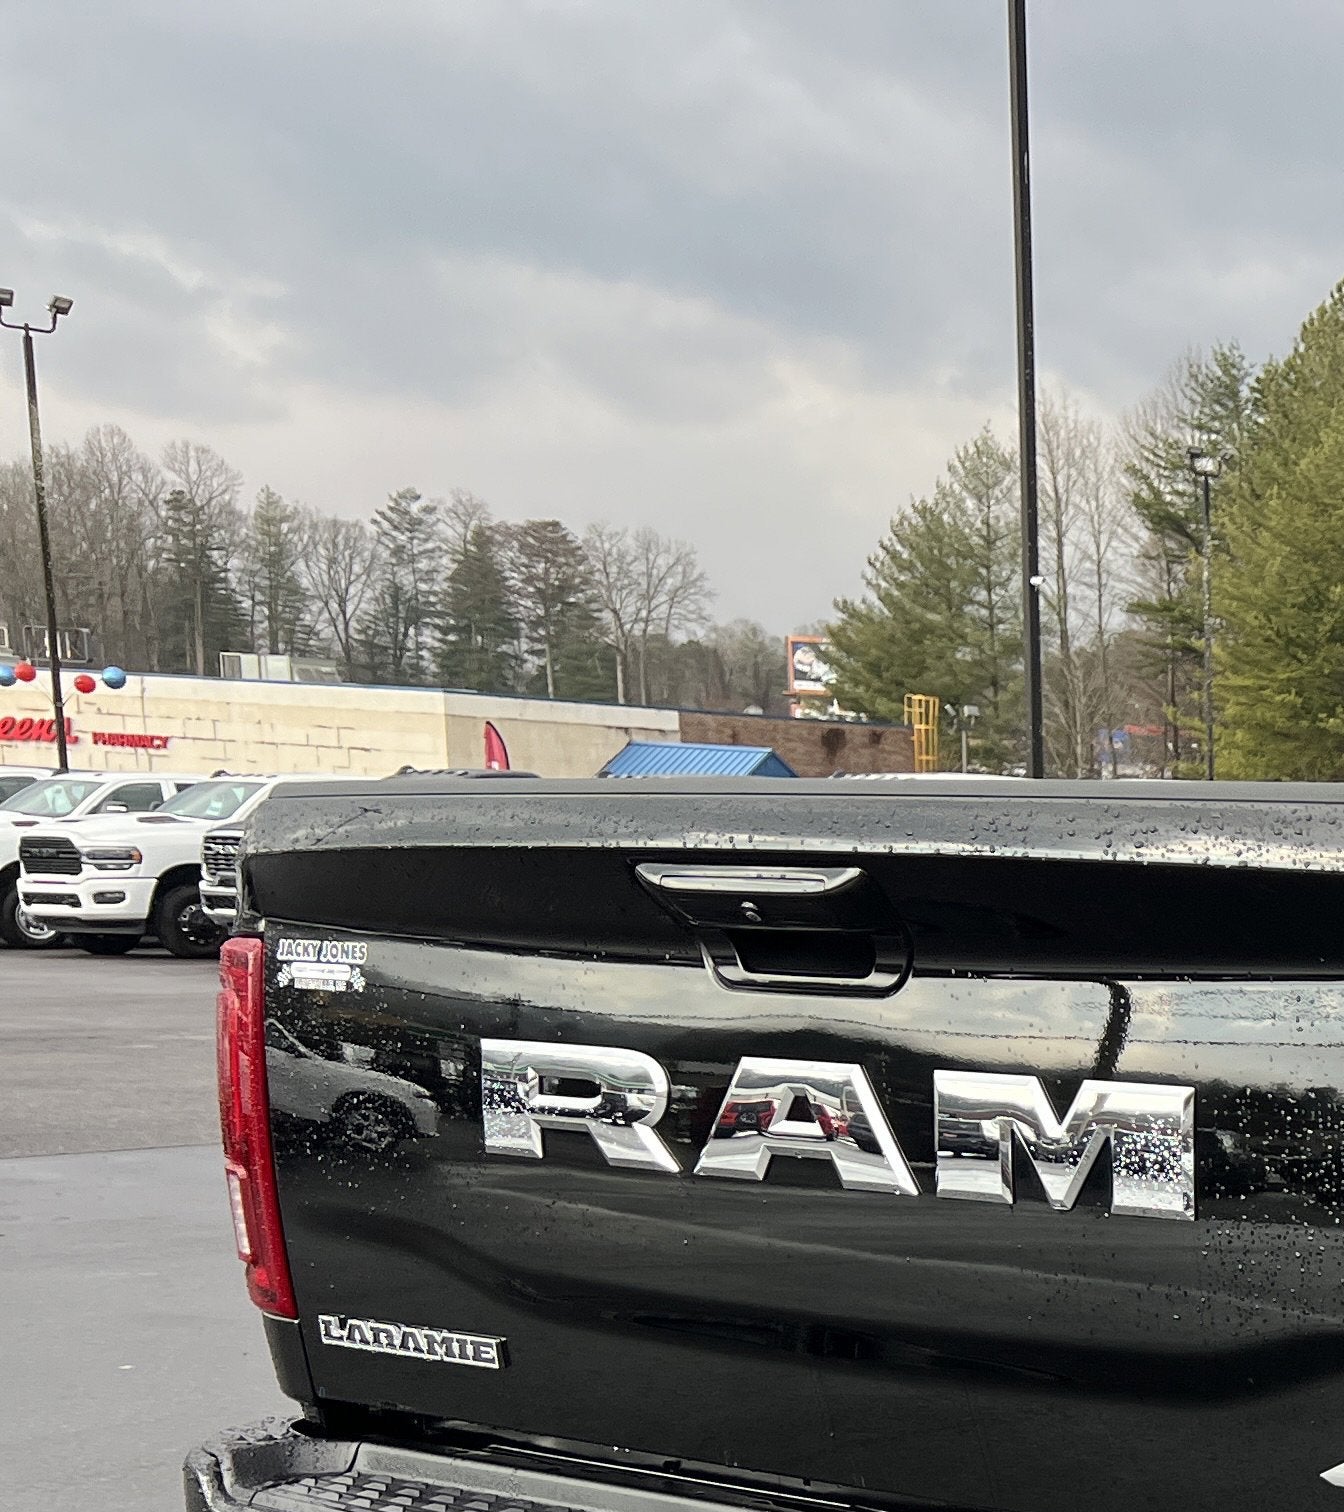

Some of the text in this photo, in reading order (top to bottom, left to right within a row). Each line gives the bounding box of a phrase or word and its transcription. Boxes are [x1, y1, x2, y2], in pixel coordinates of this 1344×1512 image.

[92, 732, 170, 749] PHARMACY
[277, 939, 367, 964] JACKY JONES
[480, 1037, 1198, 1222] RAM
[318, 1315, 500, 1369] LARAMIE
